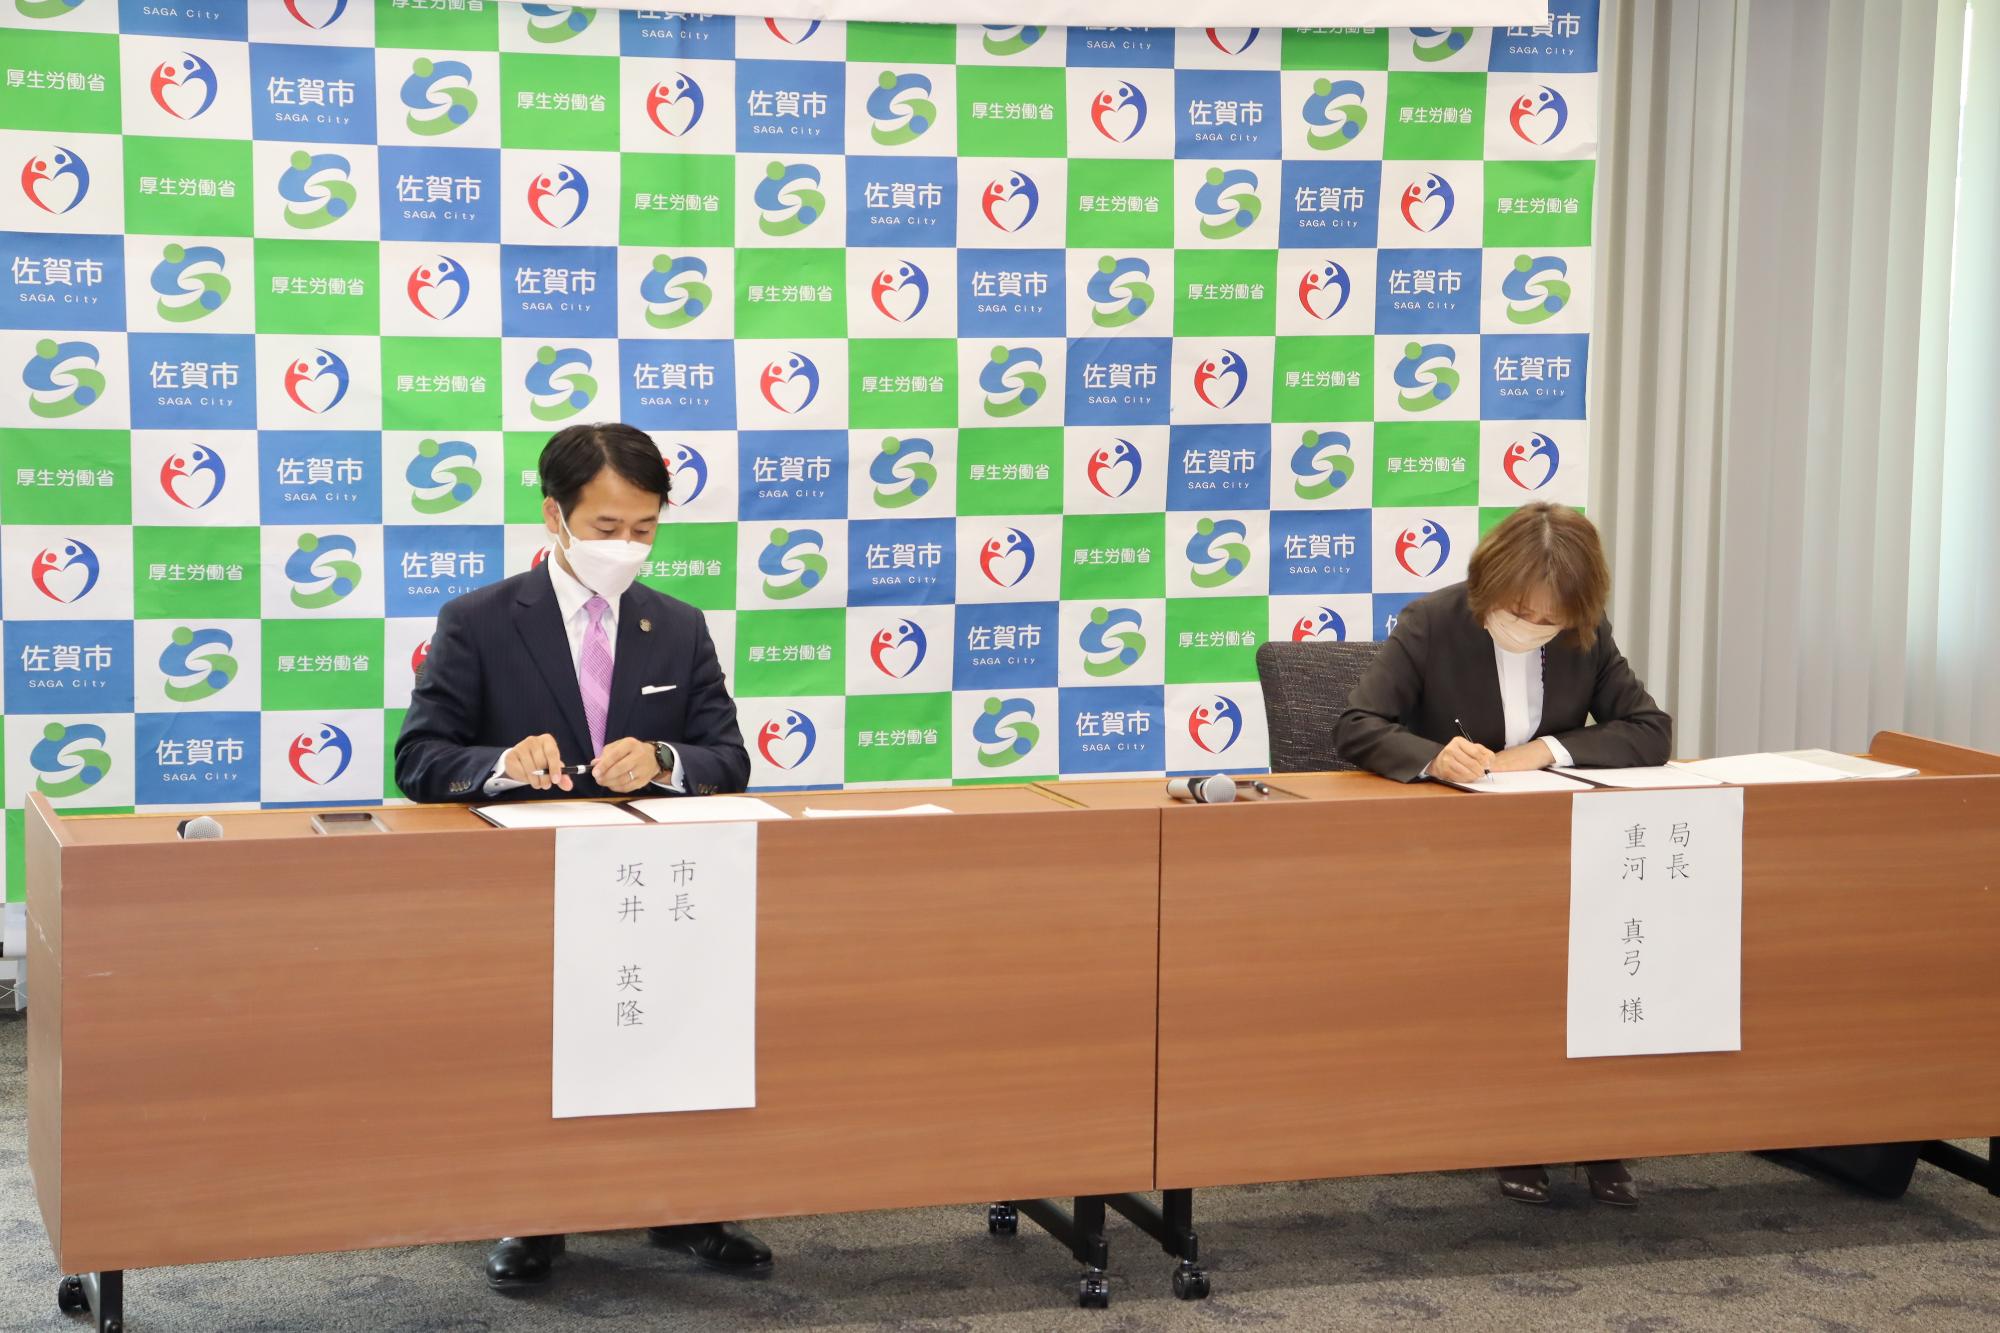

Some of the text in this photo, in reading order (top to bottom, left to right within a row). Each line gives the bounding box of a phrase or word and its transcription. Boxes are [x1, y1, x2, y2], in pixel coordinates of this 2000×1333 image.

[142, 5, 220, 21] SAGA City
[641, 28, 709, 41] SAGA City
[1086, 40, 1151, 50] SAGA City
[1508, 45, 1575, 56] SAGA City
[6, 68, 106, 93] 厚生労働省
[266, 75, 355, 107] 佐賀市
[516, 91, 606, 112] 厚生労働省
[747, 89, 828, 119] 佐賀市
[971, 101, 1055, 121] 厚生労働省
[274, 112, 349, 125] SAGA City
[1187, 99, 1264, 127] 佐賀市
[1399, 106, 1473, 125] 厚生労働省
[751, 124, 821, 136] SAGA City
[1194, 131, 1259, 143] SAGA City
[139, 175, 236, 198] 厚生労働省
[395, 174, 481, 204] 佐賀市
[863, 181, 943, 209] 佐賀市
[634, 192, 720, 213] 厚生労働省
[1079, 195, 1160, 214] 厚生労働省
[1294, 186, 1365, 213] 佐賀市
[1497, 197, 1580, 214] 厚生労働省
[402, 210, 476, 221] SAGA City
[870, 215, 937, 225] SAGA City
[1298, 218, 1358, 229] SAGA City
[11, 255, 104, 288] 佐賀市
[271, 275, 365, 297] 厚生労働省
[514, 267, 597, 296] 佐賀市
[971, 271, 1049, 298] 佐賀市
[1388, 268, 1463, 295] 佐賀市
[18, 292, 98, 305] SAGA City
[748, 284, 833, 303] 厚生労働省
[1188, 283, 1265, 300] 厚生労働省
[521, 301, 591, 312] SAGA City
[976, 303, 1043, 314] SAGA City
[1393, 300, 1456, 311] SAGA City
[149, 360, 240, 390] 佐賀市
[633, 362, 715, 390] 佐賀市
[1082, 362, 1158, 389] 佐賀市
[1492, 355, 1572, 382] 佐賀市
[396, 374, 487, 394] 厚生労働省
[862, 375, 945, 393] 厚生労働省
[1285, 370, 1361, 388] 厚生労働省
[157, 396, 234, 407] SAGA City
[639, 396, 710, 407] SAGA City
[1087, 395, 1152, 405] SAGA City
[1497, 387, 1565, 397] SAGA City
[276, 457, 364, 485] 佐賀市
[752, 455, 832, 483] 佐賀市
[1182, 448, 1256, 475] 佐賀市
[1387, 456, 1467, 473] 厚生労働省
[16, 467, 114, 488] 厚生労働省
[970, 463, 1050, 481] 厚生労働省
[758, 489, 825, 499] SAGA City
[1187, 481, 1249, 490] SAGA City
[282, 492, 358, 502] SAGA City
[865, 542, 943, 570] 佐賀市
[1073, 547, 1152, 565] 厚生労働省
[1283, 533, 1356, 561] 佐賀市
[148, 563, 244, 582] 厚生労働省
[400, 551, 486, 579] 佐賀市
[1289, 565, 1351, 575] SAGA City
[871, 575, 937, 586] SAGA City
[408, 586, 480, 595] SAGA Cit
[967, 623, 1042, 651] 佐賀市
[1178, 630, 1257, 648] 厚生労働省
[20, 644, 113, 673] 佐賀市
[748, 644, 833, 663] 厚生労働省
[971, 656, 1036, 667] SAGA City
[278, 654, 369, 673] 厚生労働省
[27, 679, 106, 689] SAGA City
[1075, 710, 1152, 737] 佐賀市
[857, 728, 938, 748] 厚生労働省
[1081, 742, 1146, 753] SAGA City
[155, 737, 244, 766] 佐賀市
[162, 771, 238, 782] SAGA City
[1666, 822, 1691, 880] 局長
[668, 858, 697, 923] 市長
[1619, 823, 1647, 1024] 重河 真弓 様
[616, 862, 645, 1027] 坂井 英隆
